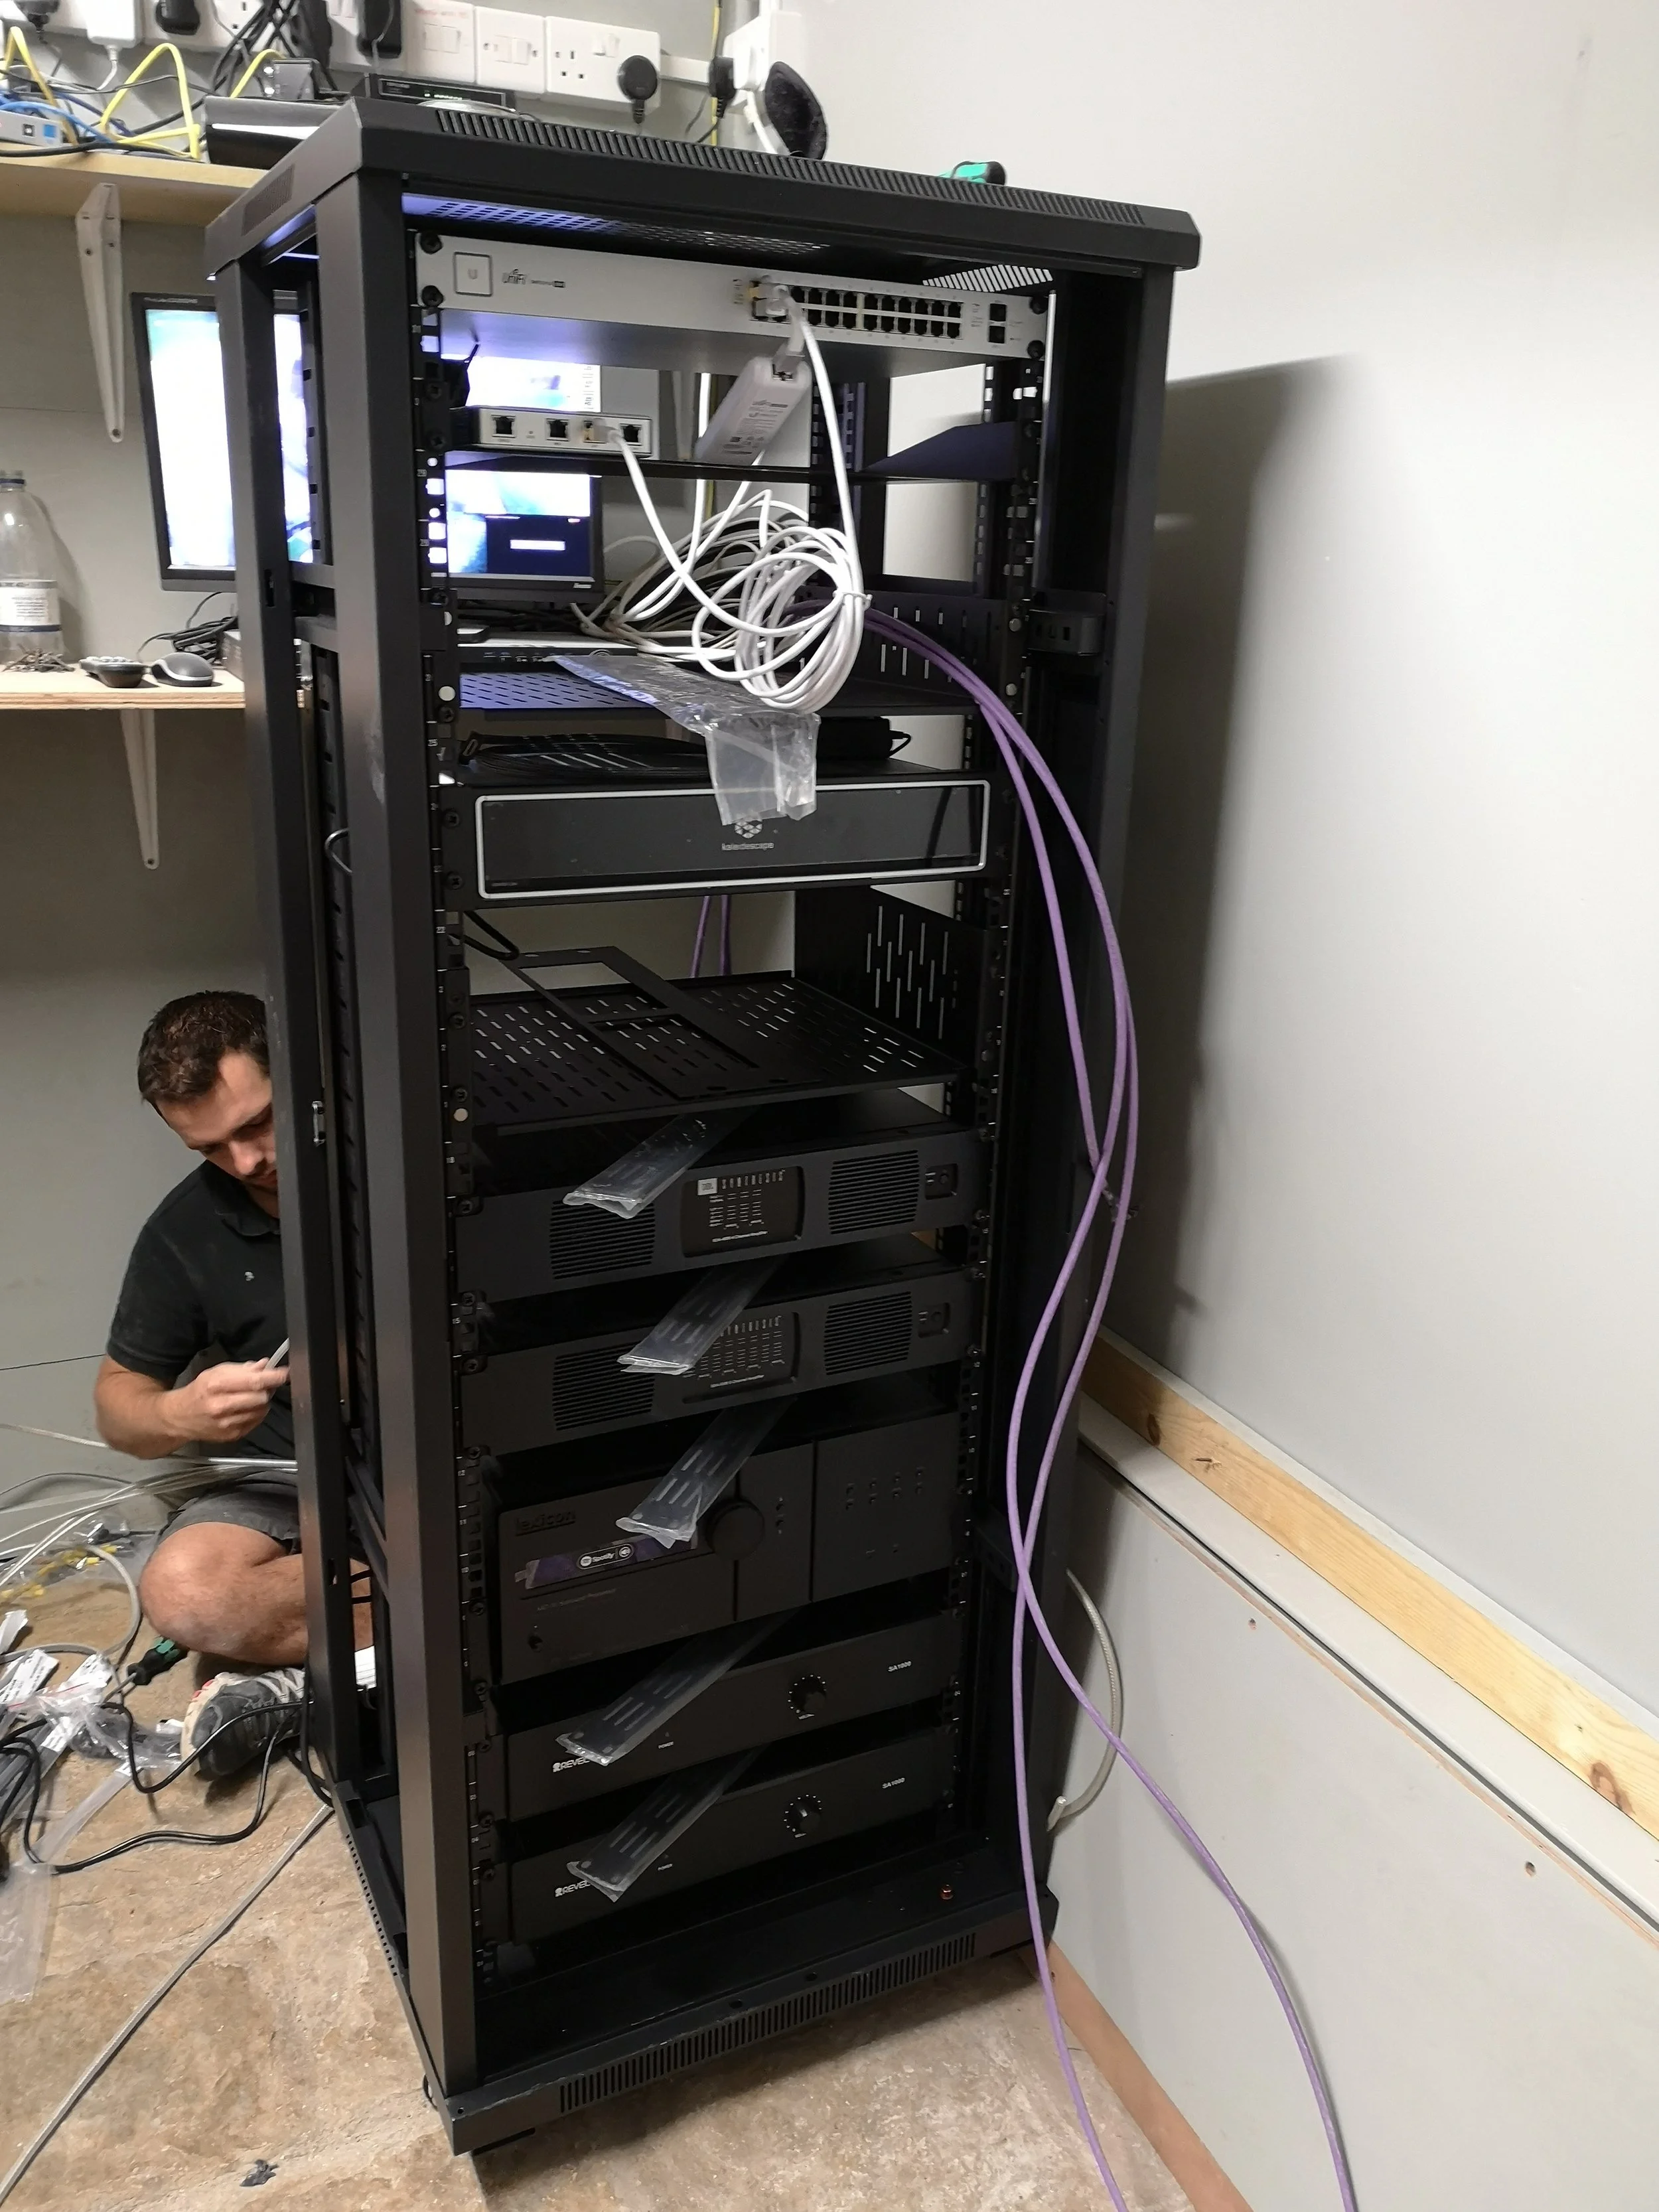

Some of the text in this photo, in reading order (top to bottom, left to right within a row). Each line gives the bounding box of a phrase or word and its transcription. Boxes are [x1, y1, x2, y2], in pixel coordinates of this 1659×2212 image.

[591, 1552, 615, 1563] Spotify
[559, 1757, 591, 1769] REVEL
[561, 1880, 591, 1895] REVEL
